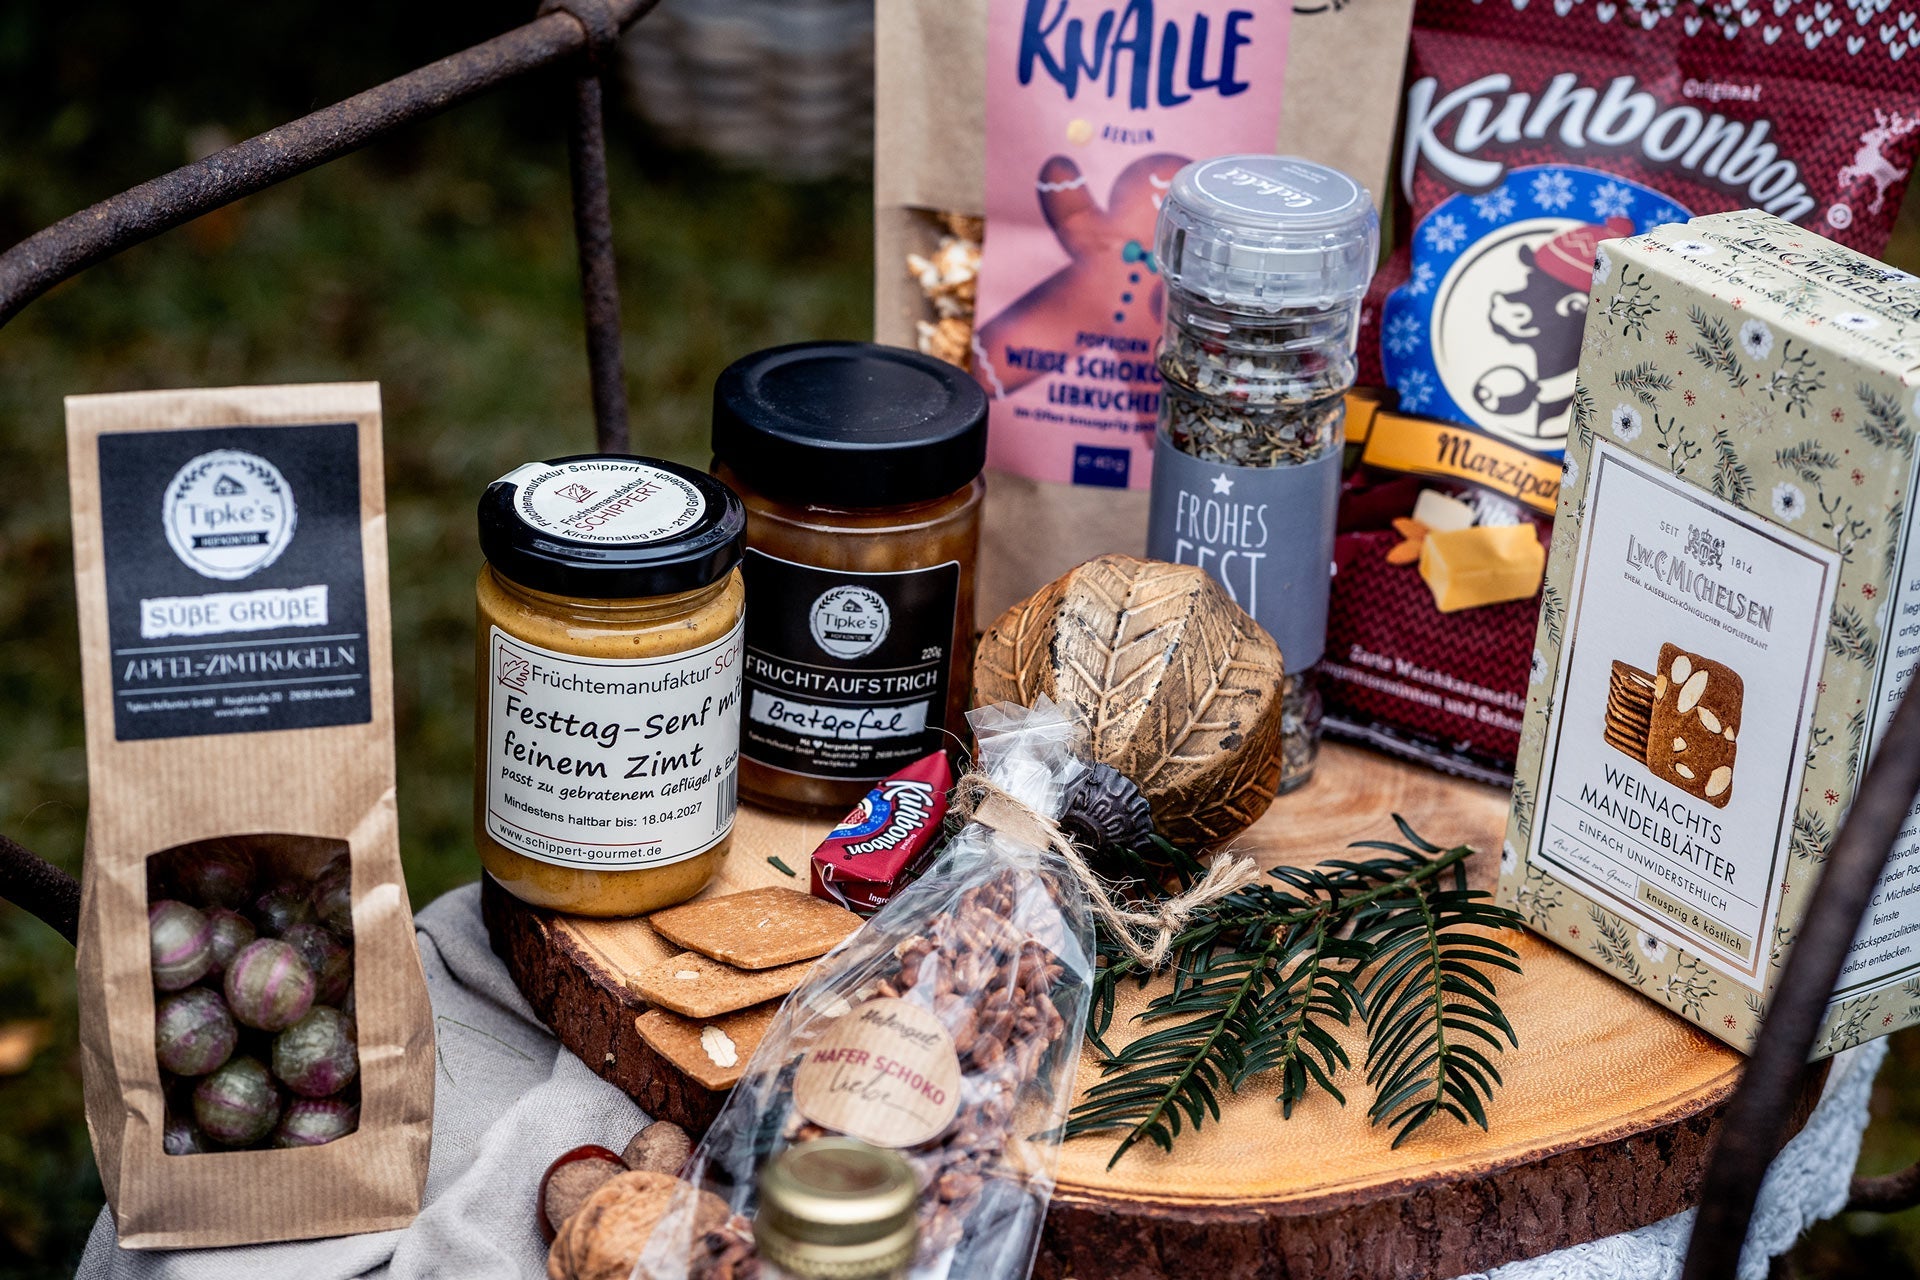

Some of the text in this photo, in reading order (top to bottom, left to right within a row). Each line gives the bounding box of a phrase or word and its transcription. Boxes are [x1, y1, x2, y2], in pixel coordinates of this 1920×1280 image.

[1017, 0, 1254, 110] KNALLE
[1682, 78, 1763, 102] Original
[1102, 124, 1155, 144] BERLIN
[1403, 73, 1816, 221] Kuhbonbon
[568, 463, 641, 475] Schippert
[523, 468, 566, 528] Früchtemanufaktur
[559, 477, 646, 527] Früchtemanufaktur
[574, 480, 664, 533] SCHIPPERT
[653, 471, 700, 508] Grünendeich
[185, 498, 276, 530] Tipke's
[649, 526, 670, 538] 2A
[673, 507, 697, 527] 21720
[1175, 490, 1269, 548] FROHES
[562, 528, 649, 542] Kirchenstieg
[1659, 521, 1753, 574] SEIT 1814
[1623, 572, 1643, 588] EHEM.
[1722, 622, 1769, 651] HOFLIEFERANT
[1666, 555, 1774, 633] MICHELSEN
[823, 612, 879, 631] Tipke's
[830, 632, 867, 642] HOFKONTOR
[123, 646, 356, 682] APFEL-ZIMTKUGELN
[531, 663, 713, 696] Früchtemanufaktur
[745, 654, 938, 695] FRUCHTAUFSTRICH
[505, 694, 713, 749] Festtag-Senf
[768, 700, 908, 740] Bratapfel
[504, 729, 705, 780] feinem Zimt
[501, 765, 534, 788] passt
[537, 781, 554, 794] zu
[558, 785, 655, 802] gebratenem
[660, 769, 712, 798] Geflügel
[714, 765, 723, 778] &
[504, 793, 565, 823] Mindestens
[568, 812, 612, 828] haltbar
[615, 815, 638, 828] bis:
[642, 801, 703, 826] 18.04.2027
[848, 780, 934, 856] Kuhbonbon
[1604, 763, 1723, 845] WEINACHTS
[499, 823, 663, 861] www.schippert-gourmet.de
[1580, 783, 1736, 885] MANDELBLÄTTER
[1570, 847, 1591, 865] Liebe
[1592, 861, 1605, 874] zum
[1578, 820, 1728, 912] EINFACH UNWIDERSTEHLICH
[1646, 887, 1742, 951] knusprig & köstlich
[1872, 909, 1900, 927] feinste
[1842, 946, 1913, 976] selbst entdecken.
[813, 1047, 947, 1107] HAFER SCHOKO
